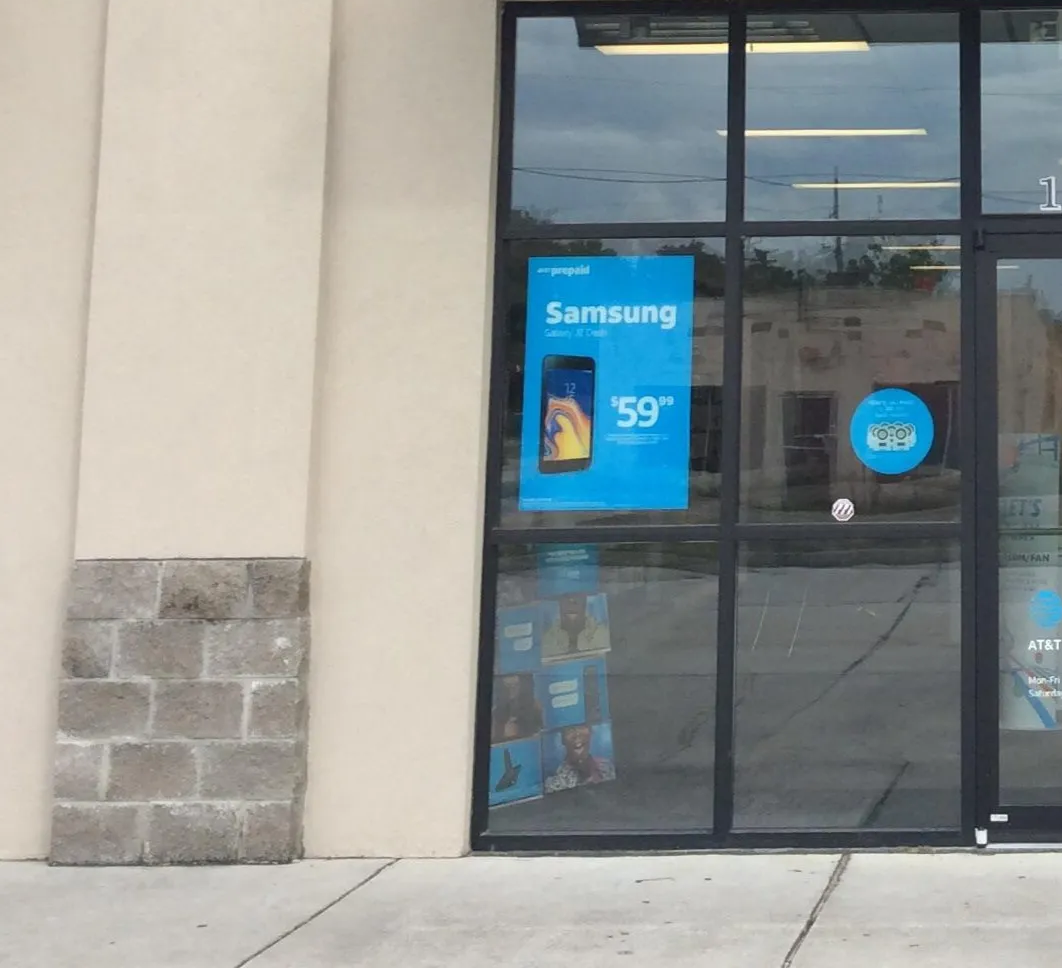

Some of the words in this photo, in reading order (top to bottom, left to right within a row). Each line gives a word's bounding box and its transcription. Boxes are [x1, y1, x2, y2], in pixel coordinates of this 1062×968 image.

[545, 301, 677, 330] Samsung
[1028, 639, 1062, 651] AT&T
[1028, 675, 1061, 685] Mon-Fri
